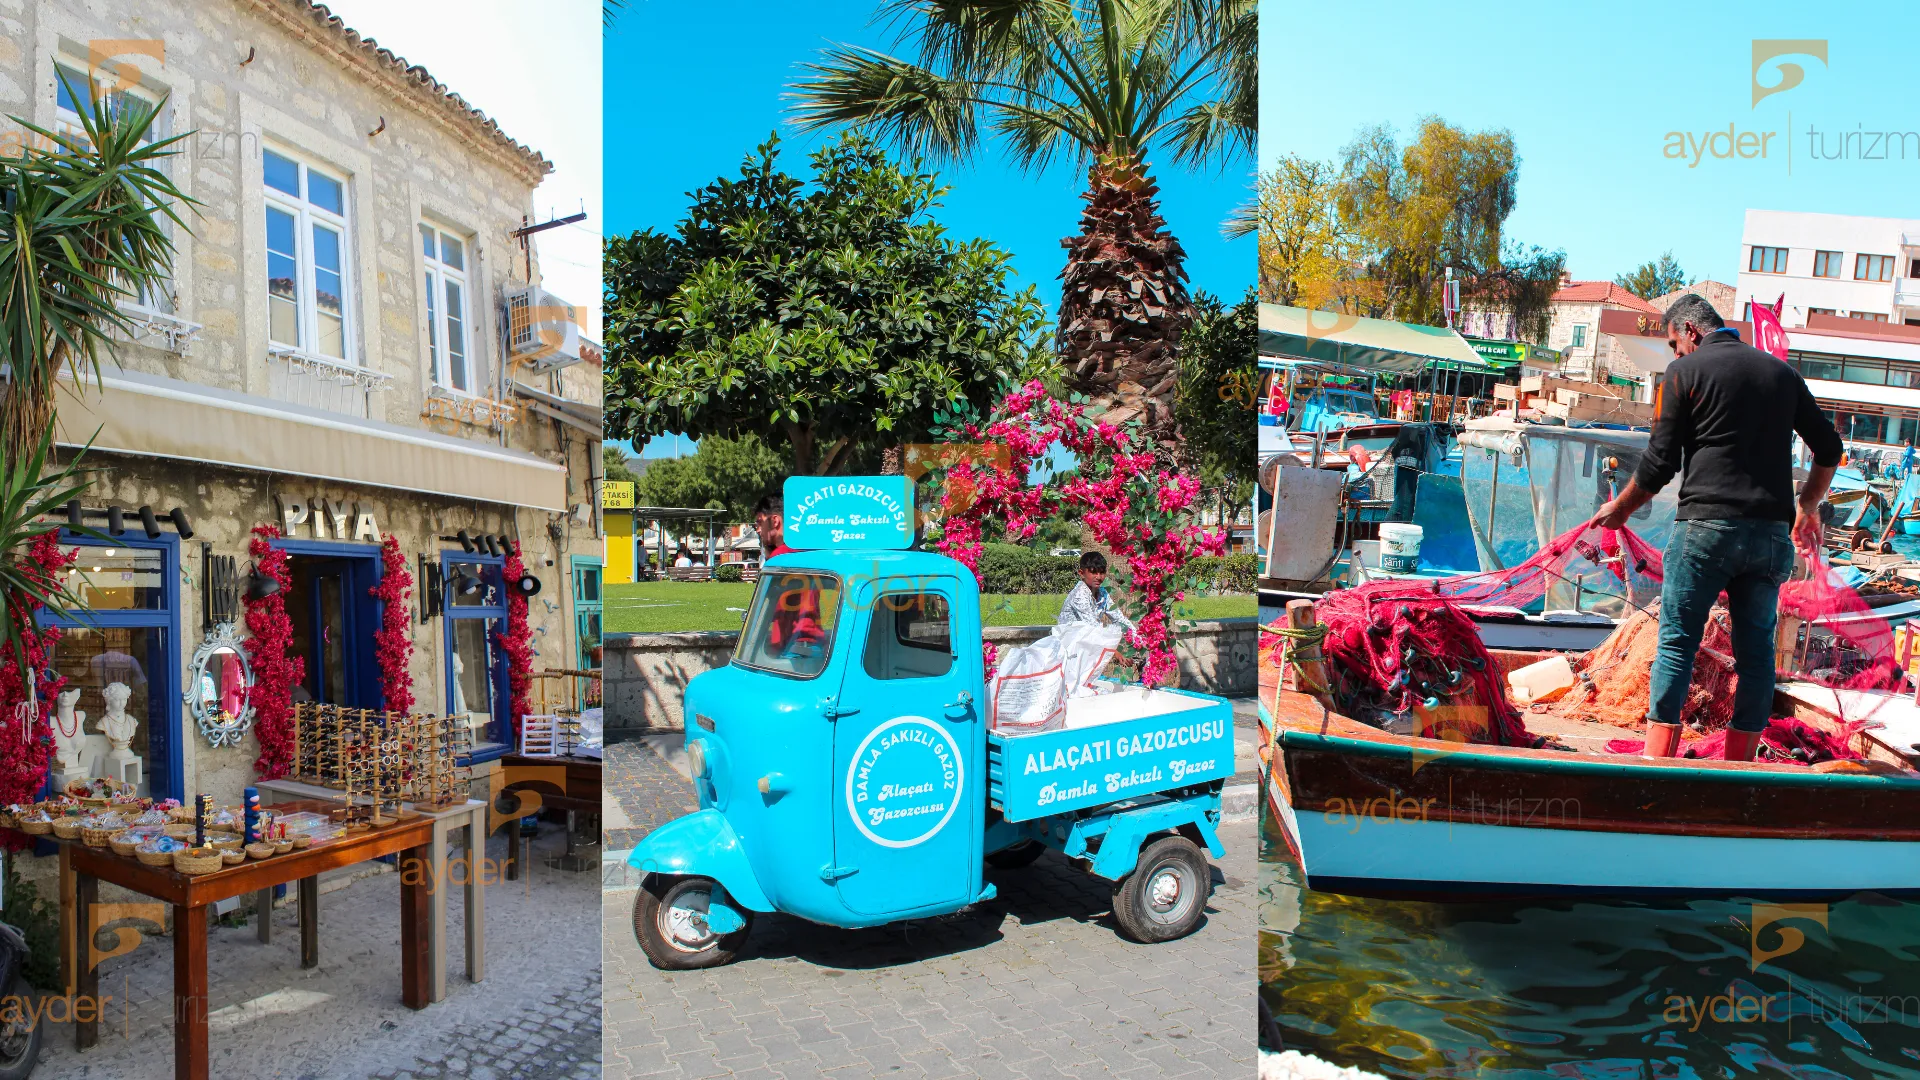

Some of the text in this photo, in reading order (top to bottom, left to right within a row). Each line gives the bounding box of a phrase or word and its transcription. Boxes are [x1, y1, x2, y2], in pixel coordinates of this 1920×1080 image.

[788, 483, 908, 533] ALAÇATI GAZOZCUSU
[805, 513, 845, 525] Damla
[830, 529, 866, 543] Gazoz
[1023, 719, 1225, 776] ALAÇATI GAZOZCUSU
[856, 729, 955, 803] DAMLA SAKIZLI GAZOZ
[1037, 758, 1216, 806] Damla Sakızlı Gazoz
[877, 781, 934, 802] Alaçatı
[867, 803, 945, 826] Gazozcusu
